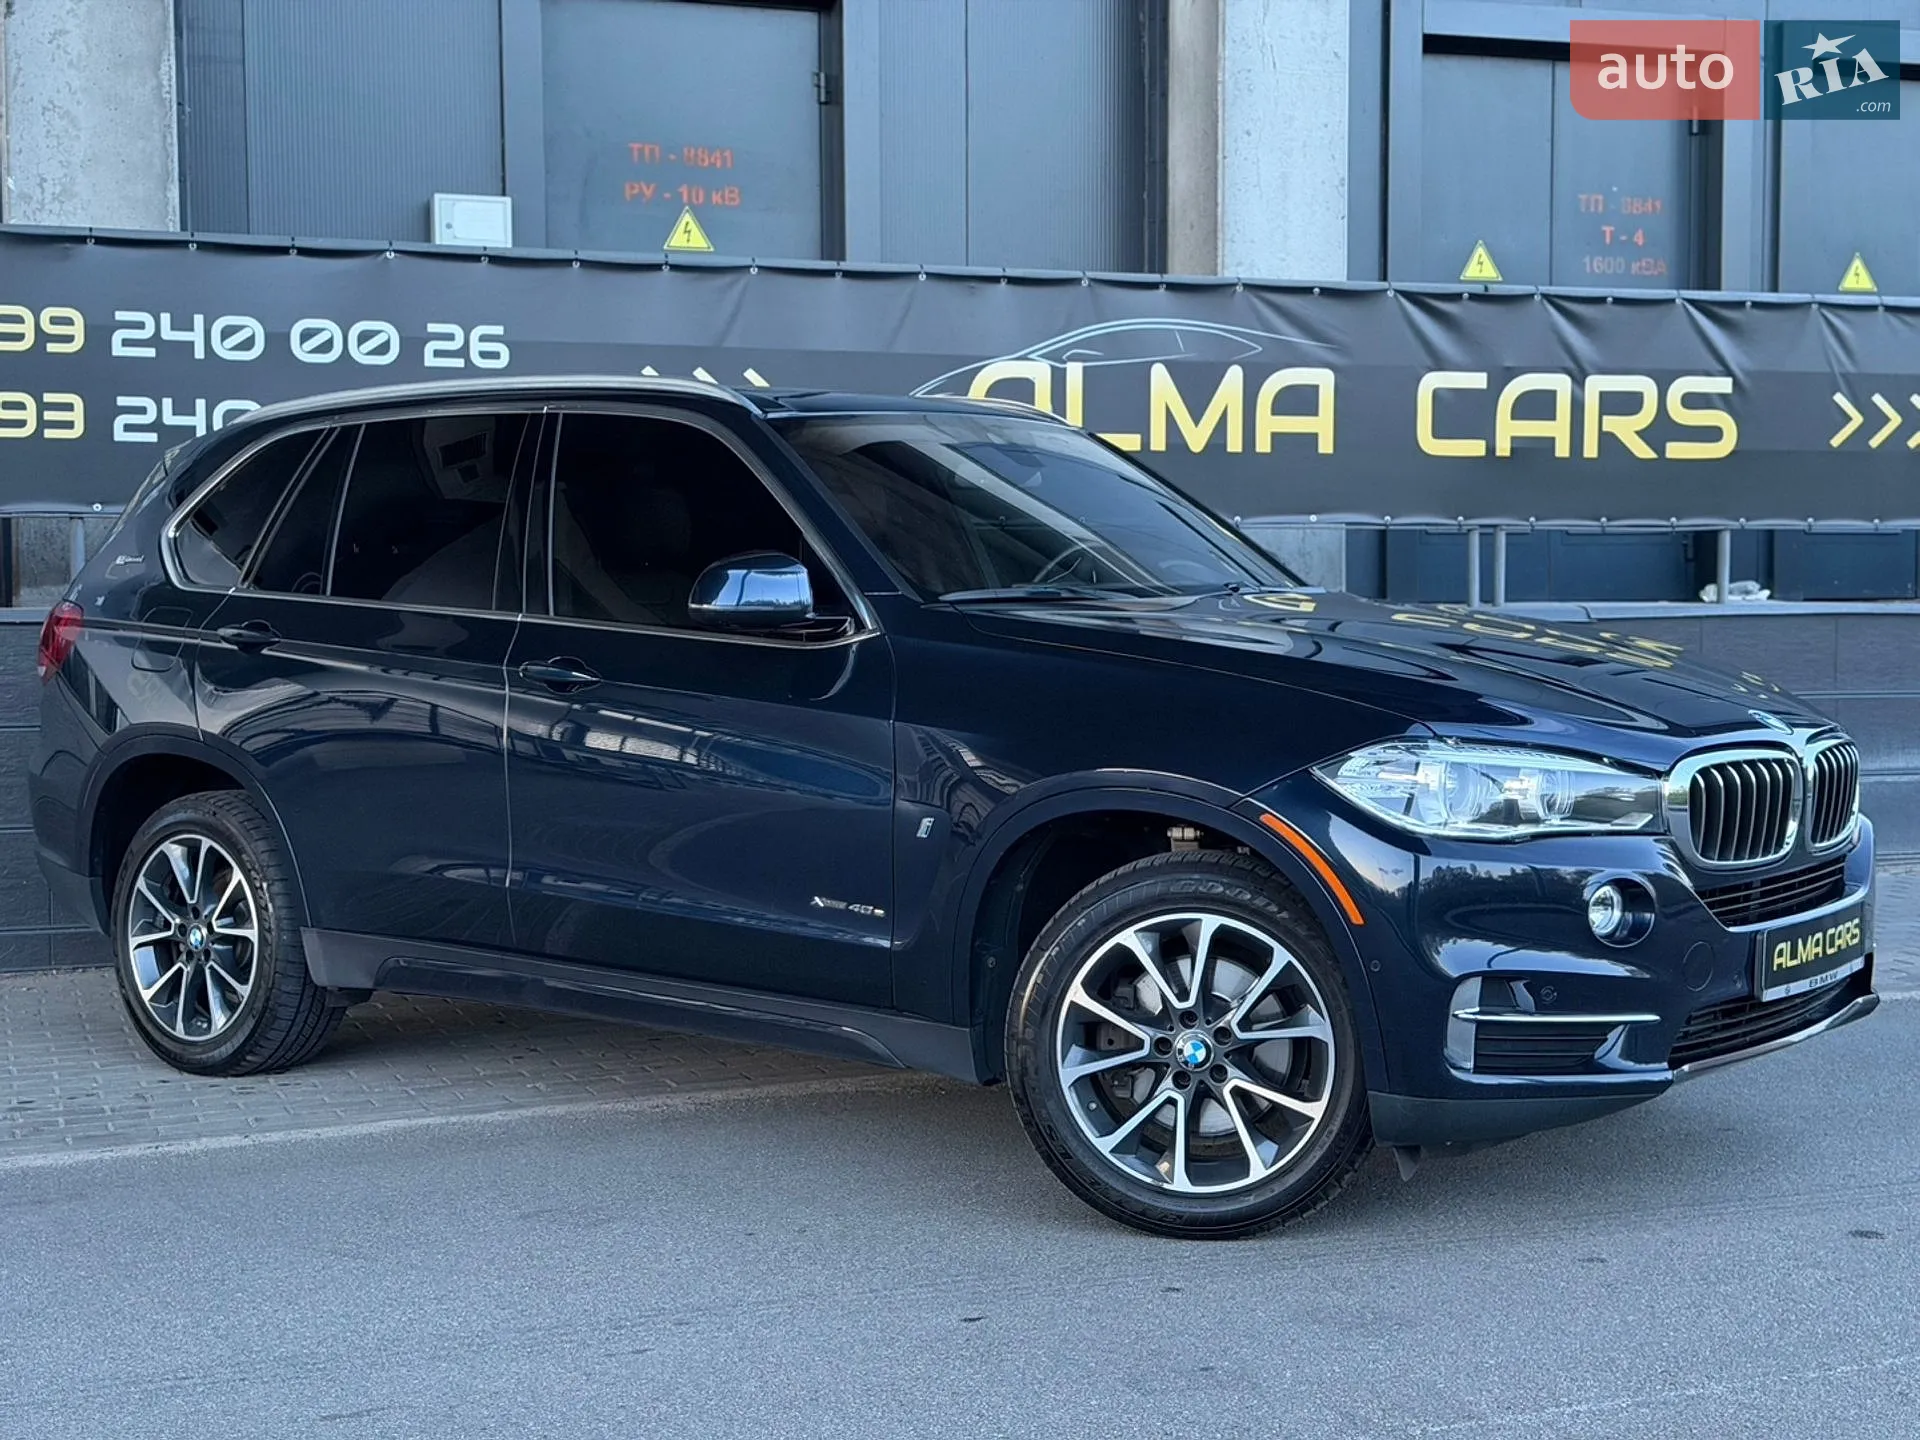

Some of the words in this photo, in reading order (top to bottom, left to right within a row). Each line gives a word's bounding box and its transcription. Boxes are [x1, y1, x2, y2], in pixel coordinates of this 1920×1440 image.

[111, 310, 266, 362] 240
[290, 318, 400, 365] 00
[423, 323, 511, 369] 26
[1416, 371, 1739, 460] CARS
[1773, 931, 1823, 971] ALMA
[1826, 917, 1860, 955] CARS
[1809, 970, 1839, 988] BMW
